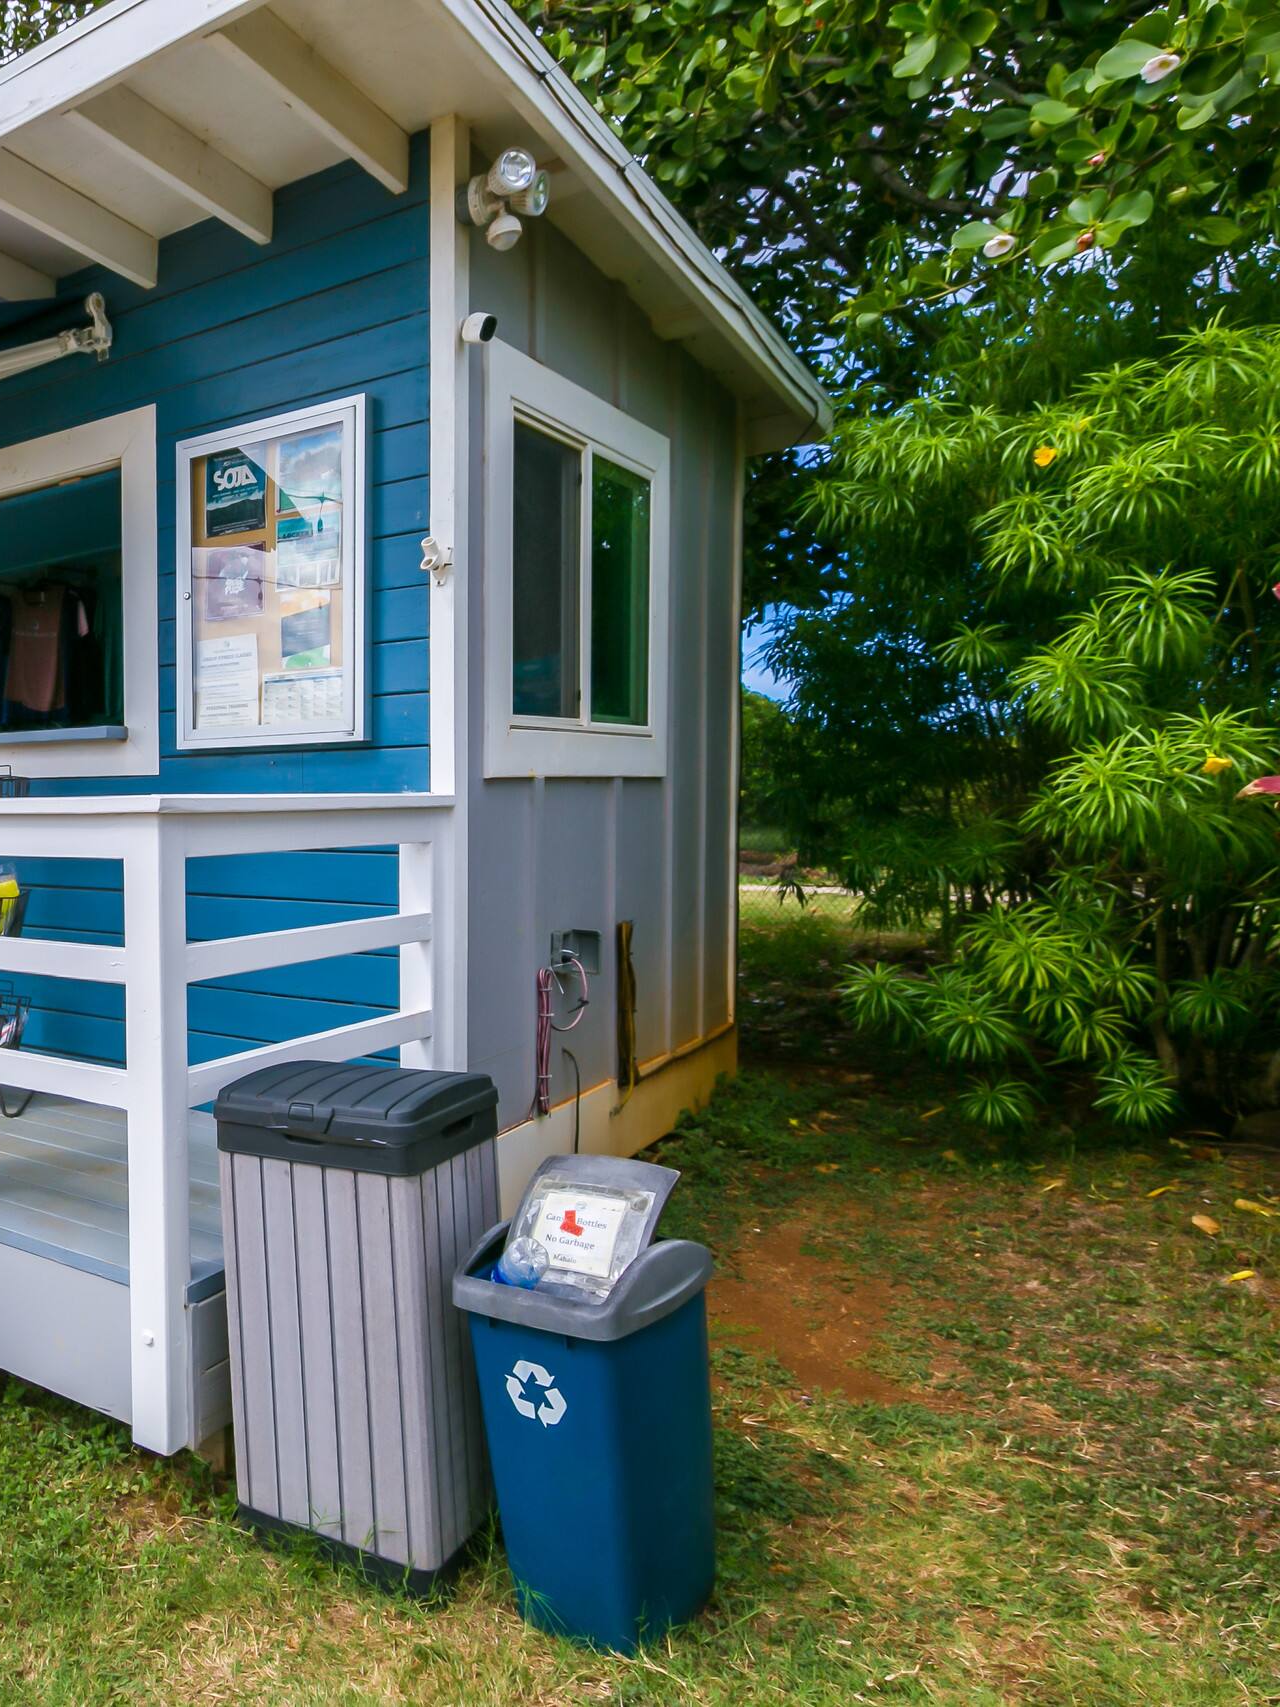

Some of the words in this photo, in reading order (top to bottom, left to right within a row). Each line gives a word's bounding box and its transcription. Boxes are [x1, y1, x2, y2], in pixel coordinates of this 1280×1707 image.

[213, 464, 258, 491] SOJA
[576, 1217, 608, 1230] Bottles
[545, 1233, 558, 1242] No
[559, 1236, 596, 1251] Garbage
